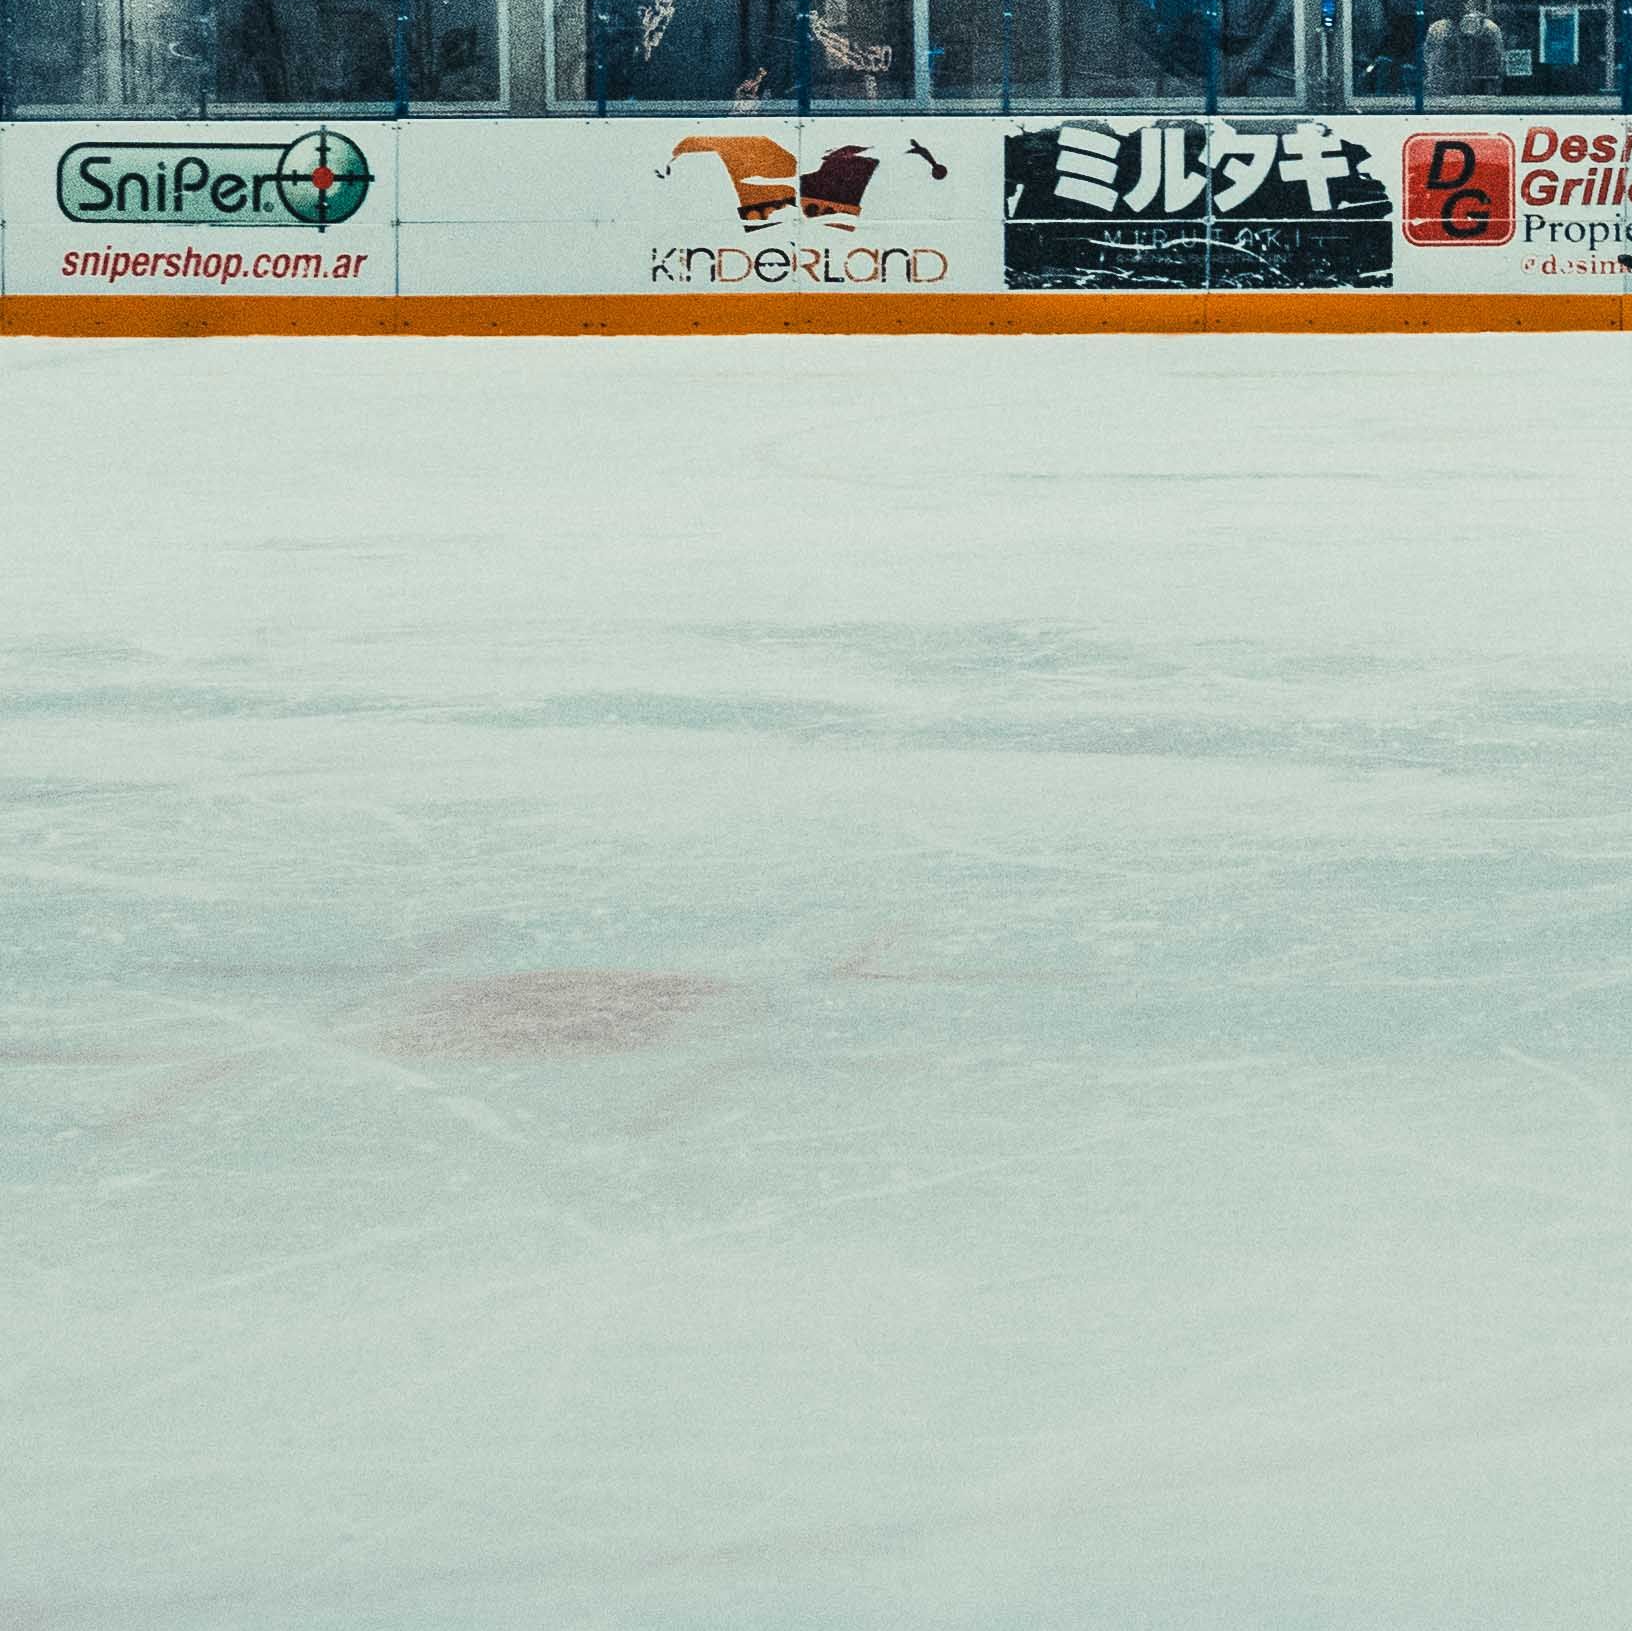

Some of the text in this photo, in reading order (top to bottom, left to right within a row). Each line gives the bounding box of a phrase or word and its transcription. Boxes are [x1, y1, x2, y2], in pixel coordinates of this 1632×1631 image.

[1054, 124, 1350, 213] ミルタキ
[61, 246, 368, 285] snipershop.com.ar
